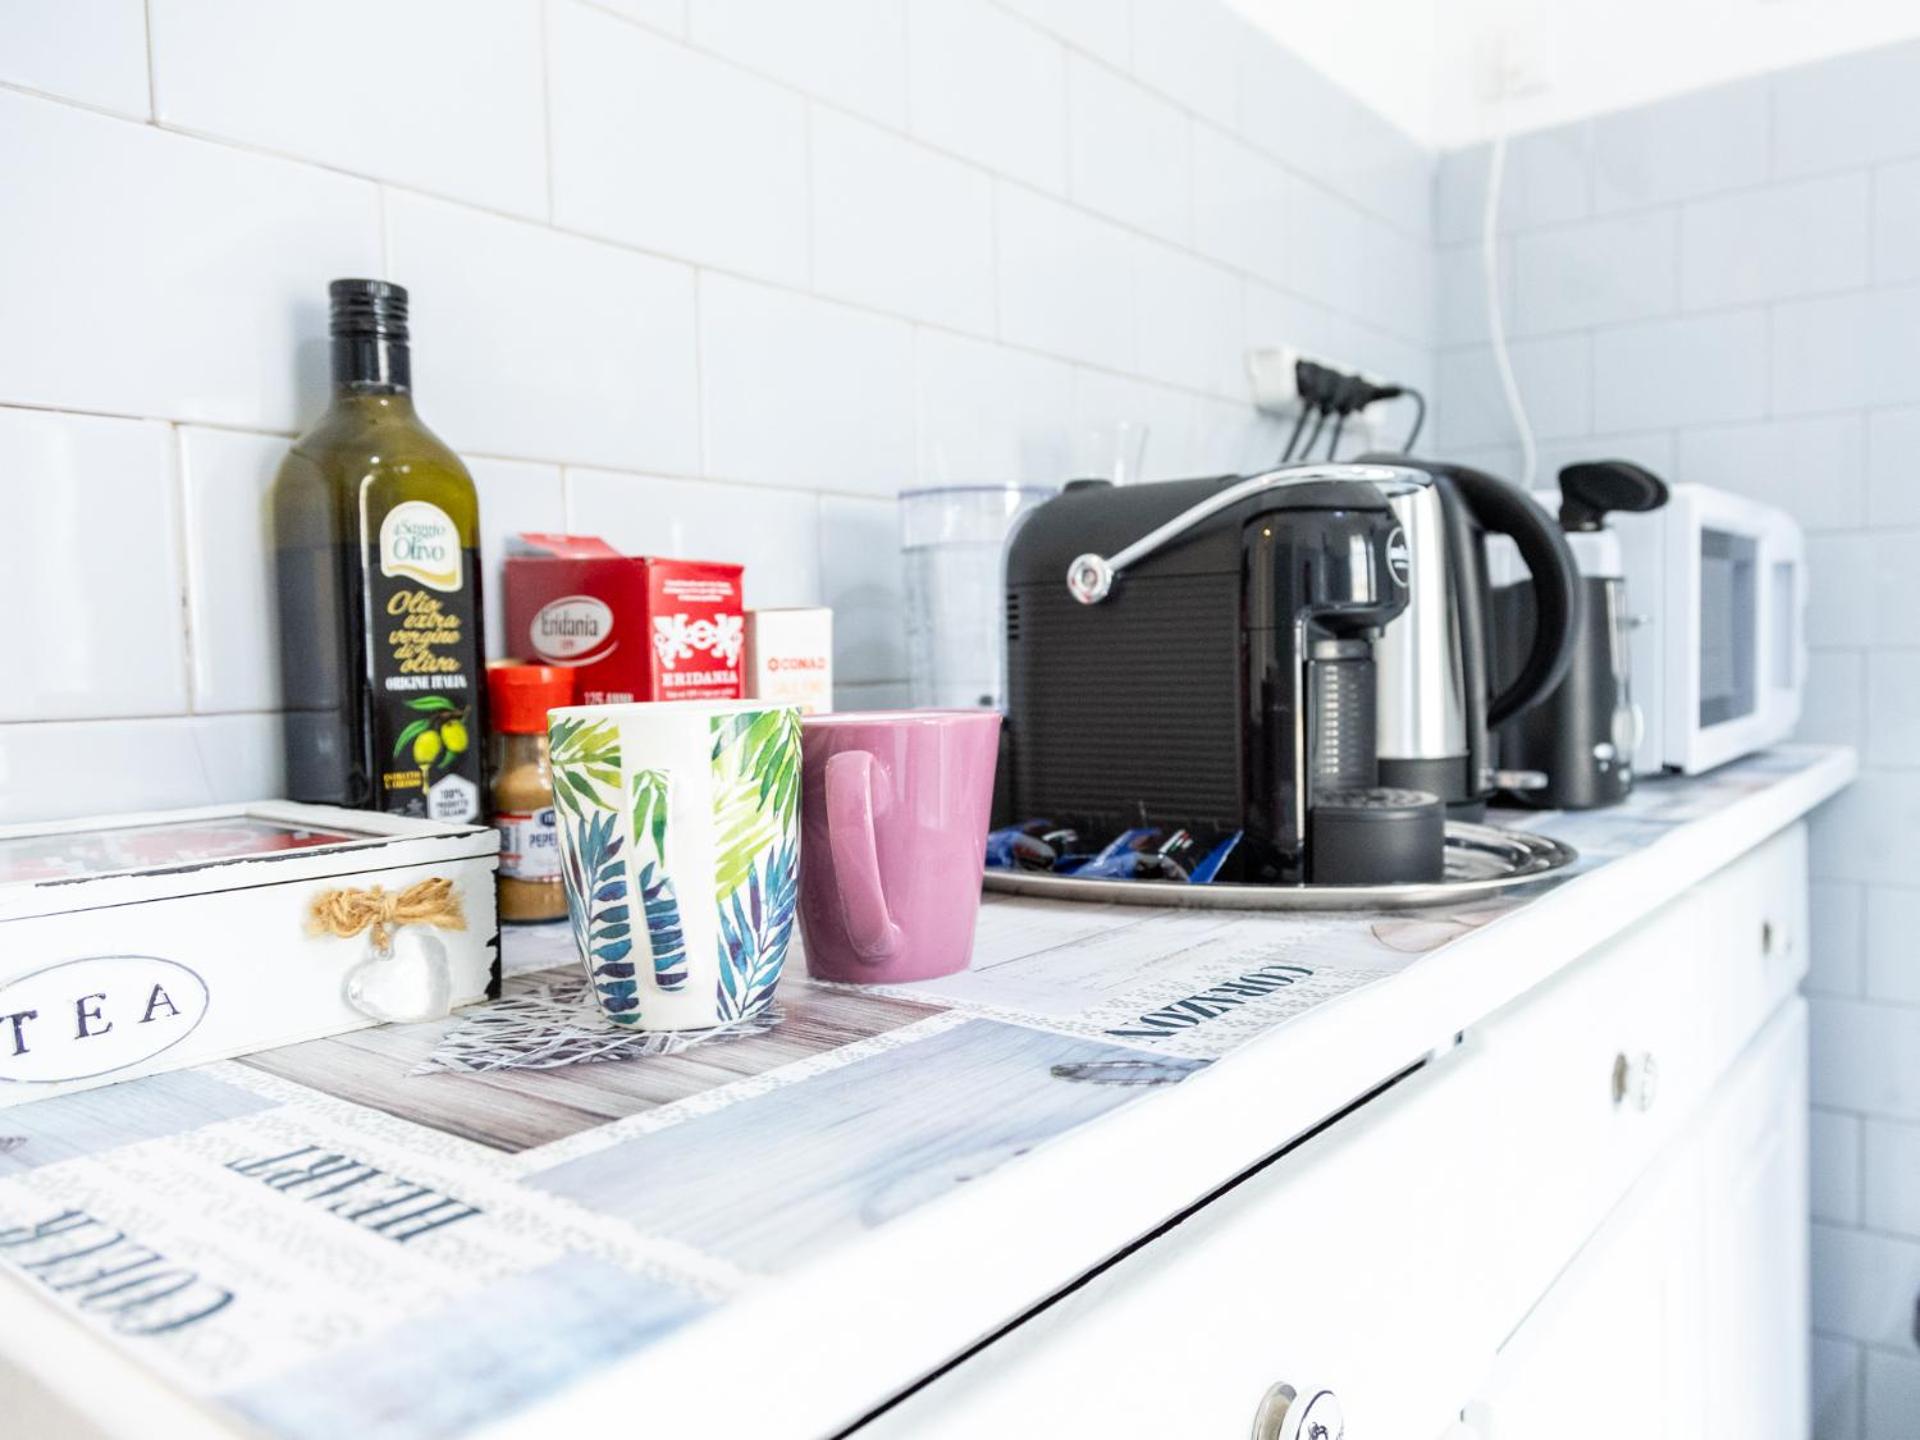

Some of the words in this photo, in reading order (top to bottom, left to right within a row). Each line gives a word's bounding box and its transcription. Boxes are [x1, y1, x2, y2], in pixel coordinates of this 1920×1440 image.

[393, 537, 445, 562] Olivo
[387, 590, 443, 615] Olio
[403, 611, 461, 629] extra
[541, 610, 598, 637] Eridania
[388, 630, 461, 651] vergine
[400, 650, 461, 673] oliva
[662, 669, 738, 686] ERIDANIA
[1103, 965, 1314, 1044] CORAZON
[0, 983, 181, 1056] TEA
[223, 1145, 483, 1243] HEART
